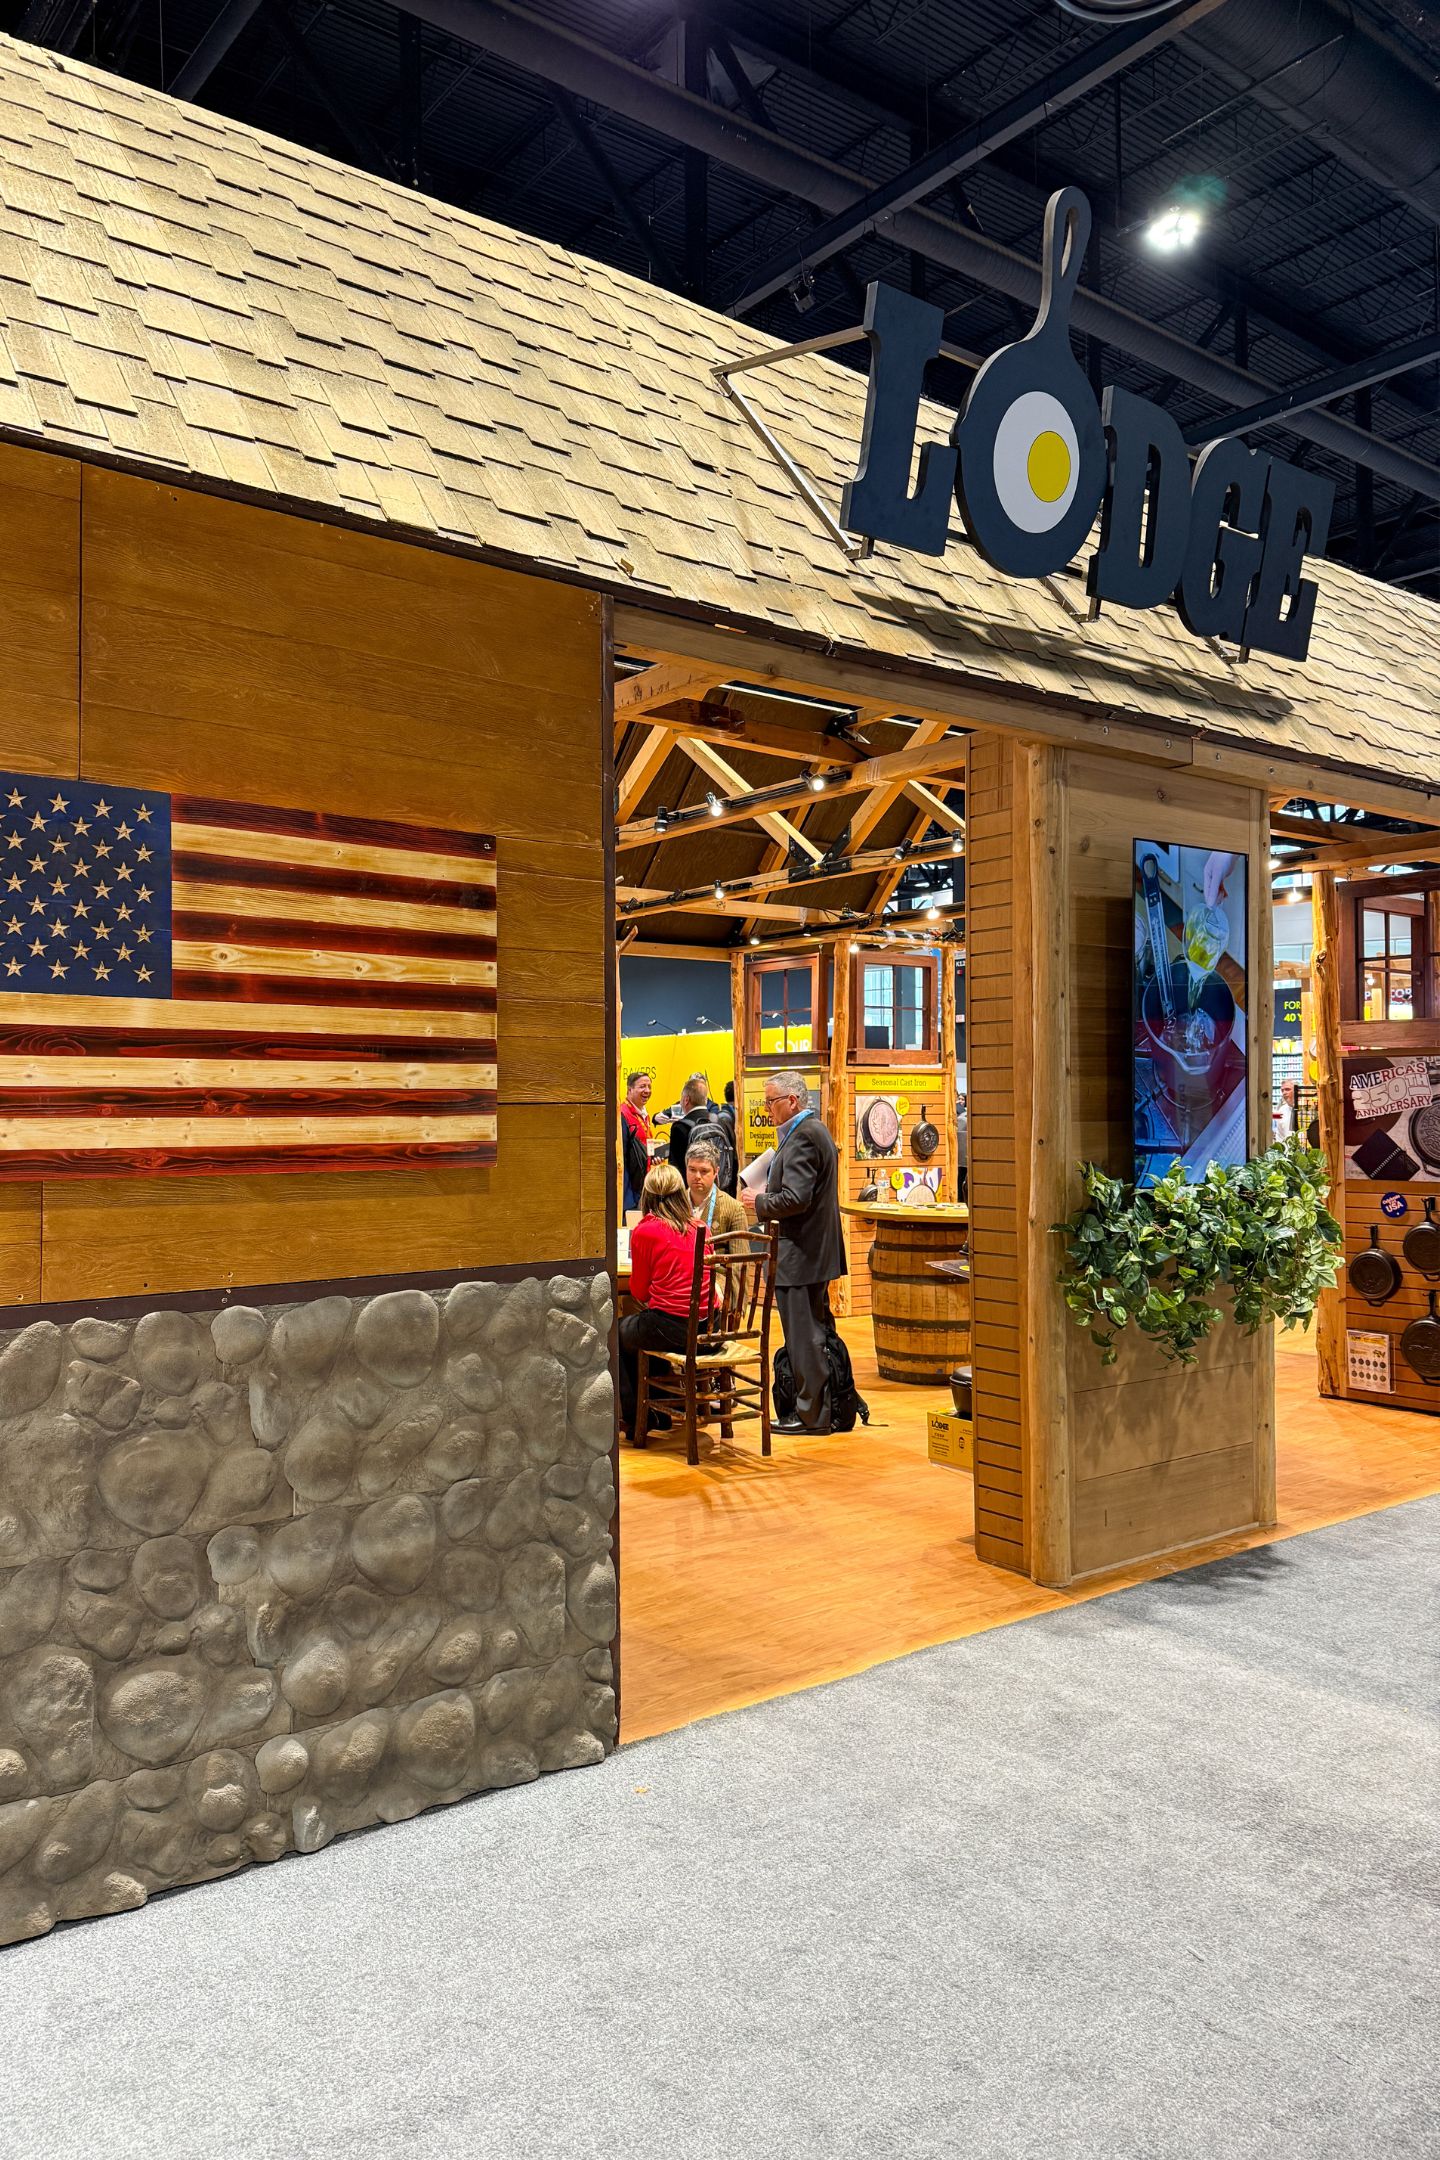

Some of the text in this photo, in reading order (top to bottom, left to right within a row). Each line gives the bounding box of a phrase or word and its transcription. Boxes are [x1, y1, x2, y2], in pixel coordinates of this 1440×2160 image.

[840, 186, 1337, 662] LODGE
[871, 1078, 927, 1087] Seasonal Cast Iron
[1351, 1063, 1426, 1089] AMERICA'S
[1356, 1096, 1432, 1118] ANNIVERSARY
[749, 1109, 774, 1127] LODG
[749, 1131, 775, 1139] Designed
[1386, 1201, 1403, 1212] USA
